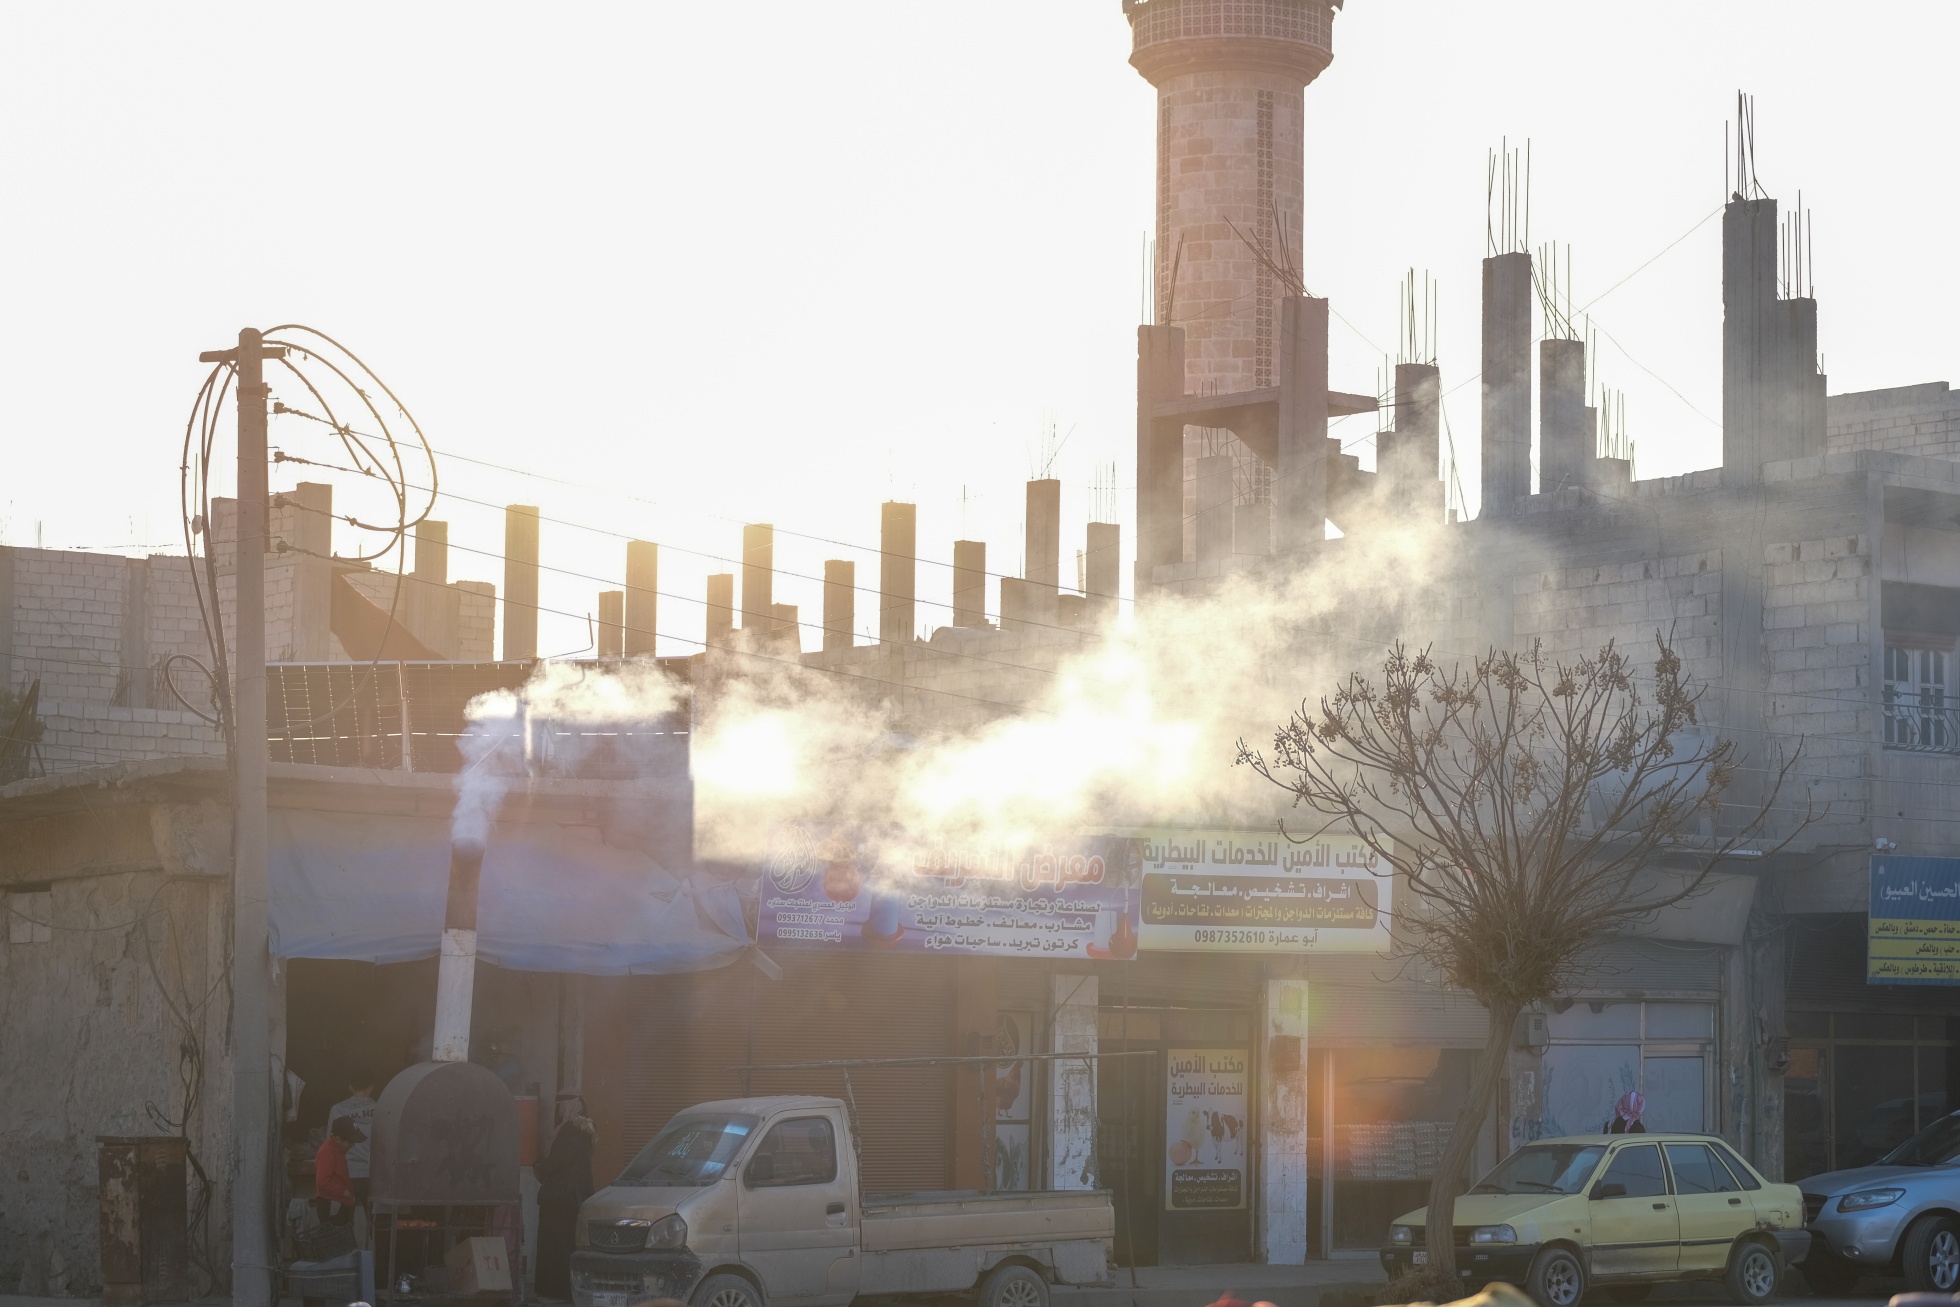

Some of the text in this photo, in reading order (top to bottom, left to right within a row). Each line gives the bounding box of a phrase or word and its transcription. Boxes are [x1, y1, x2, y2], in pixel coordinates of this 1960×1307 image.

[1143, 837, 1379, 875] مكتب الأمين للخدمات البيطرية
[1020, 843, 1106, 893] معرض
[1170, 878, 1238, 900] معالجة
[1243, 880, 1306, 902] تشخيص
[1057, 899, 1101, 914] لصناعة
[1178, 903, 1210, 917] لقاحات
[1282, 907, 1315, 922] الدواجن
[1316, 906, 1354, 922] مستلزمات
[1355, 906, 1374, 920] كافة
[776, 912, 845, 925] محمد 0993712677
[916, 912, 1092, 932] مشارب معالف خطوط آلية
[777, 927, 842, 942] ياسر 0995132636
[924, 933, 1080, 951] كرتون تبريد ساحبات هواء
[1194, 928, 1319, 947] أبو عمارة 0987352610
[1170, 1052, 1244, 1079] مكتب الأمين
[1171, 1081, 1243, 1099] للخدمات البيطرية
